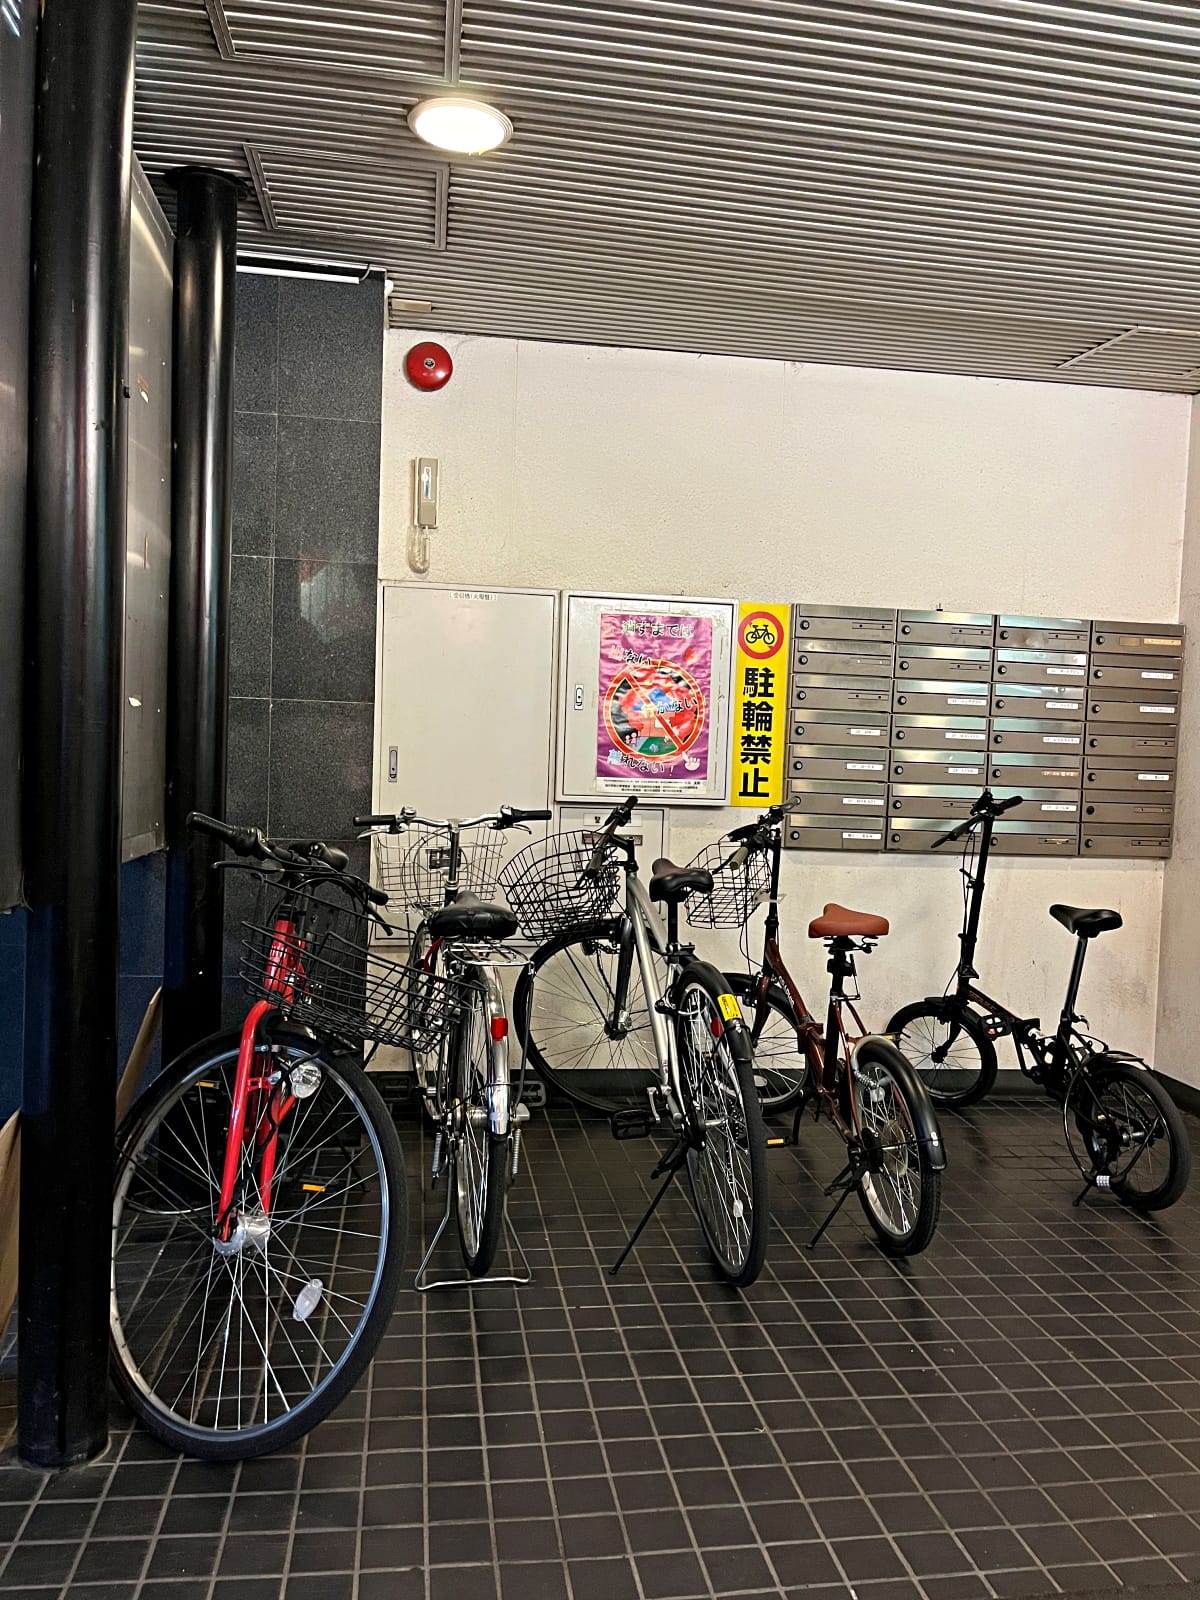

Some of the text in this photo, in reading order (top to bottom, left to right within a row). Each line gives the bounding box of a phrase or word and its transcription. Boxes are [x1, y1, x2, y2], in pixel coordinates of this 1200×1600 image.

[622, 619, 695, 639] 消すまでは
[739, 667, 775, 798] 駐輪禁止
